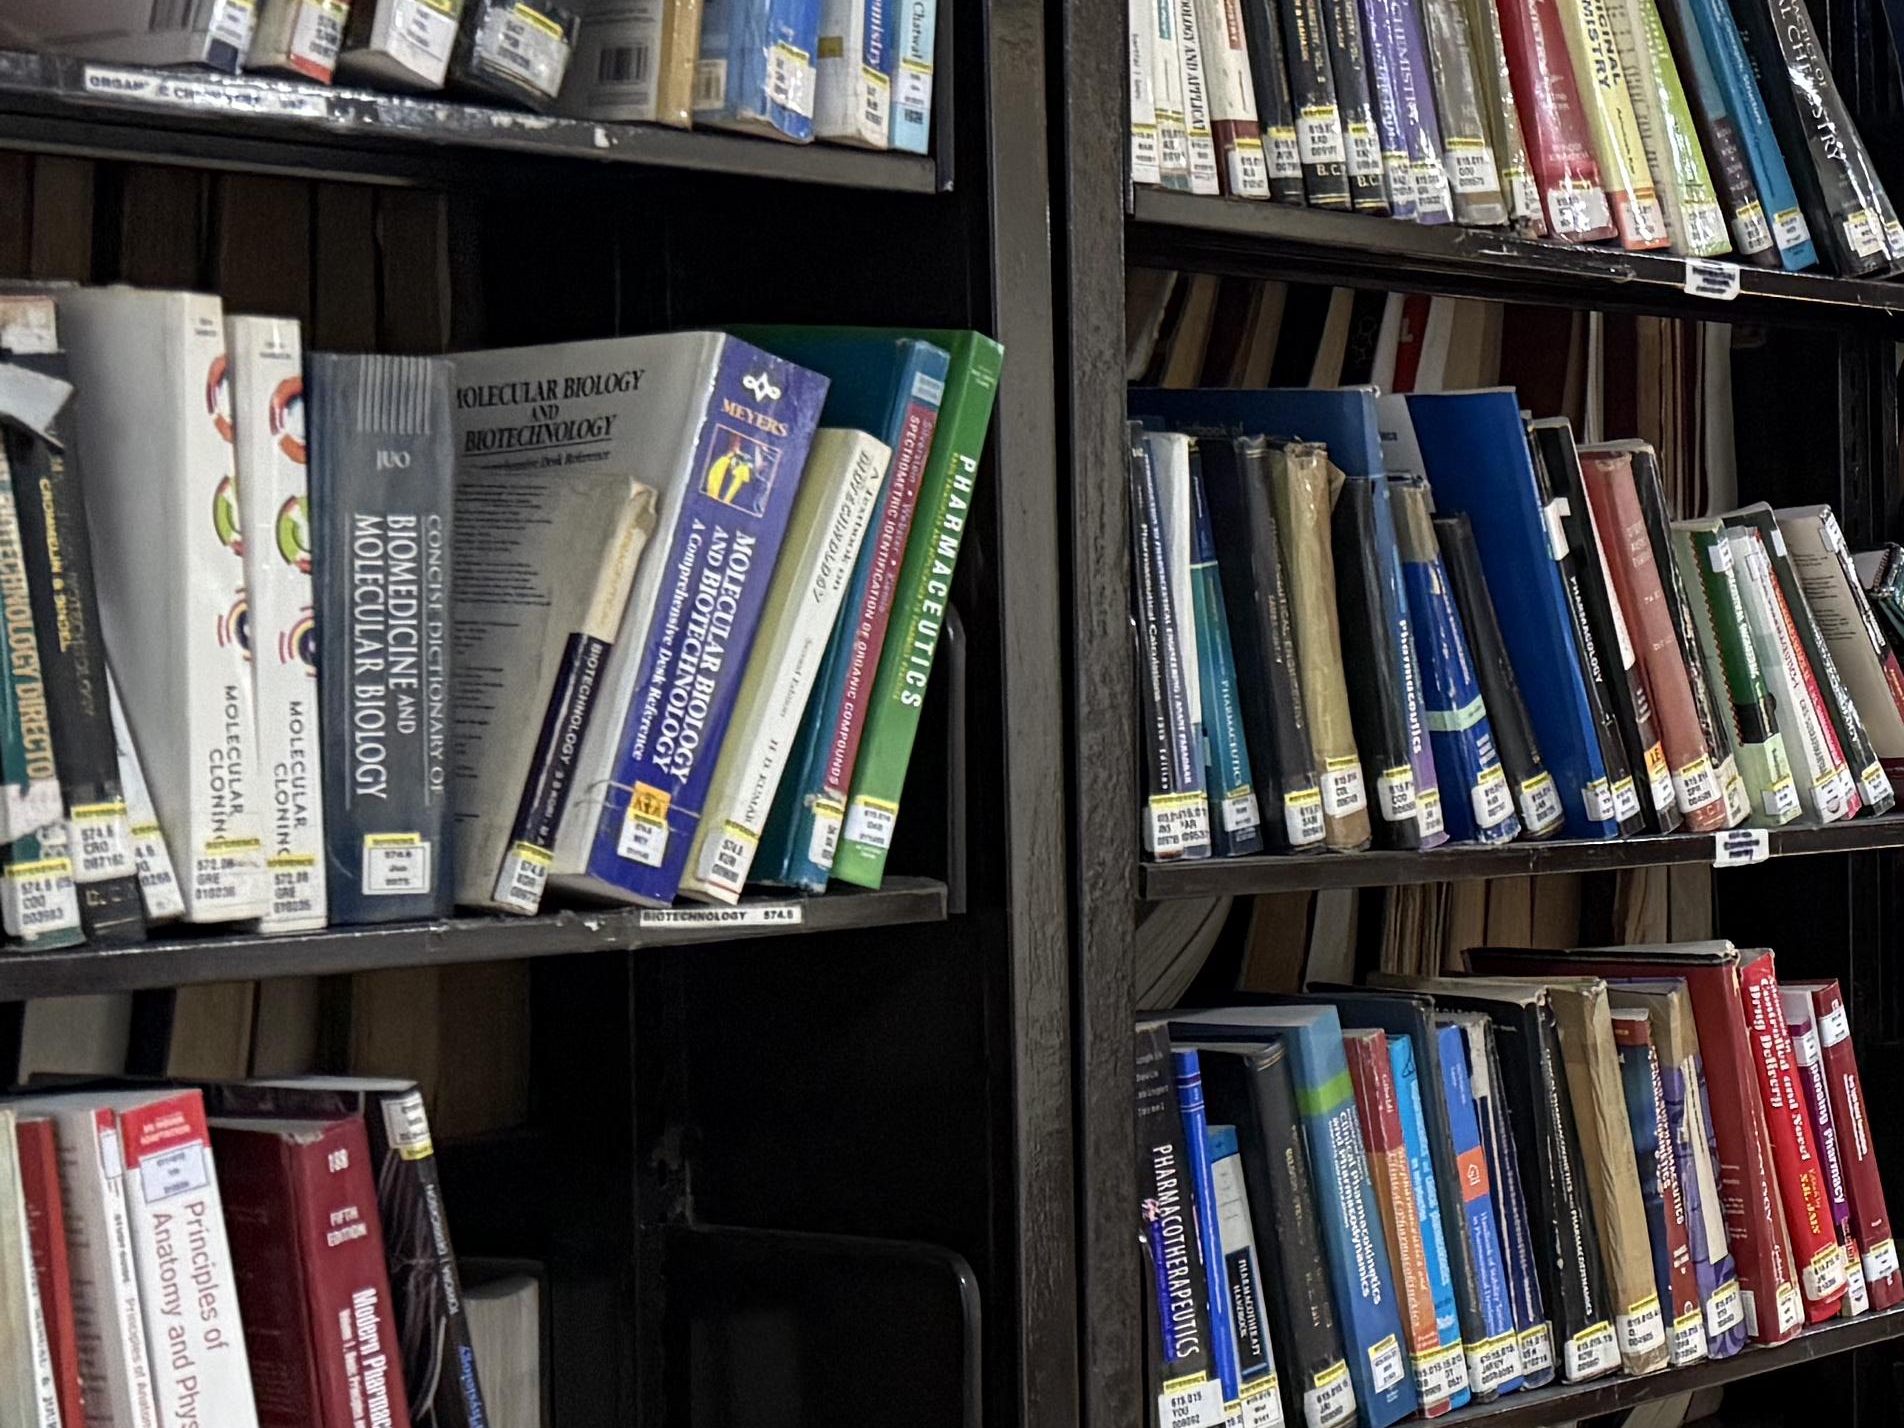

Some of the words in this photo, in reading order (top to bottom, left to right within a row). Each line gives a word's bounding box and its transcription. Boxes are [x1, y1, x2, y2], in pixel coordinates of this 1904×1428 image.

[464, 414, 616, 453] BIOTECHNOLOGY
[530, 403, 559, 422] AND
[563, 370, 644, 400] BIOLOGY
[720, 397, 788, 437] MEYERS
[354, 514, 386, 674] MOLECULAR
[387, 515, 419, 689] BIOMEDICINE
[428, 513, 442, 606] CONCISE
[706, 530, 756, 665] MOLECULAR
[900, 455, 978, 708] PHARMACEUTICS
[397, 694, 416, 734] AND
[560, 640, 603, 766] BIOTECHNOLOGY
[653, 564, 722, 777] BIOTECHNOLOGY
[675, 665, 721, 784] BIOLOGY
[225, 684, 245, 817] MOLECULAR
[290, 700, 308, 829] MOLECULAR
[355, 685, 387, 800] BIOLOGY
[829, 701, 857, 784] COMPOUNDS
[642, 910, 747, 923] BIOTECHNOLOGY
[1749, 985, 1763, 1032] Drug
[1760, 1035, 1783, 1109] Delivery
[1760, 977, 1789, 1072] Controlled
[1783, 1075, 1798, 1109] and
[1791, 1112, 1811, 1162] Novel
[329, 1205, 359, 1226] FIFTH
[1336, 1146, 1370, 1298] Pharmacodynamics
[1339, 1110, 1354, 1156] Clinical
[1347, 1158, 1381, 1306] Pharmacokinetics
[1823, 1127, 1845, 1204] Pharmacy
[153, 1213, 184, 1315] Anatomy
[169, 1318, 192, 1371] and
[184, 1200, 222, 1318] Principles
[206, 1321, 229, 1351] of
[327, 1224, 367, 1247] EDITION
[1152, 1144, 1200, 1359] PHARMACOTHERAPEUTICS
[352, 1287, 379, 1358] Modern
